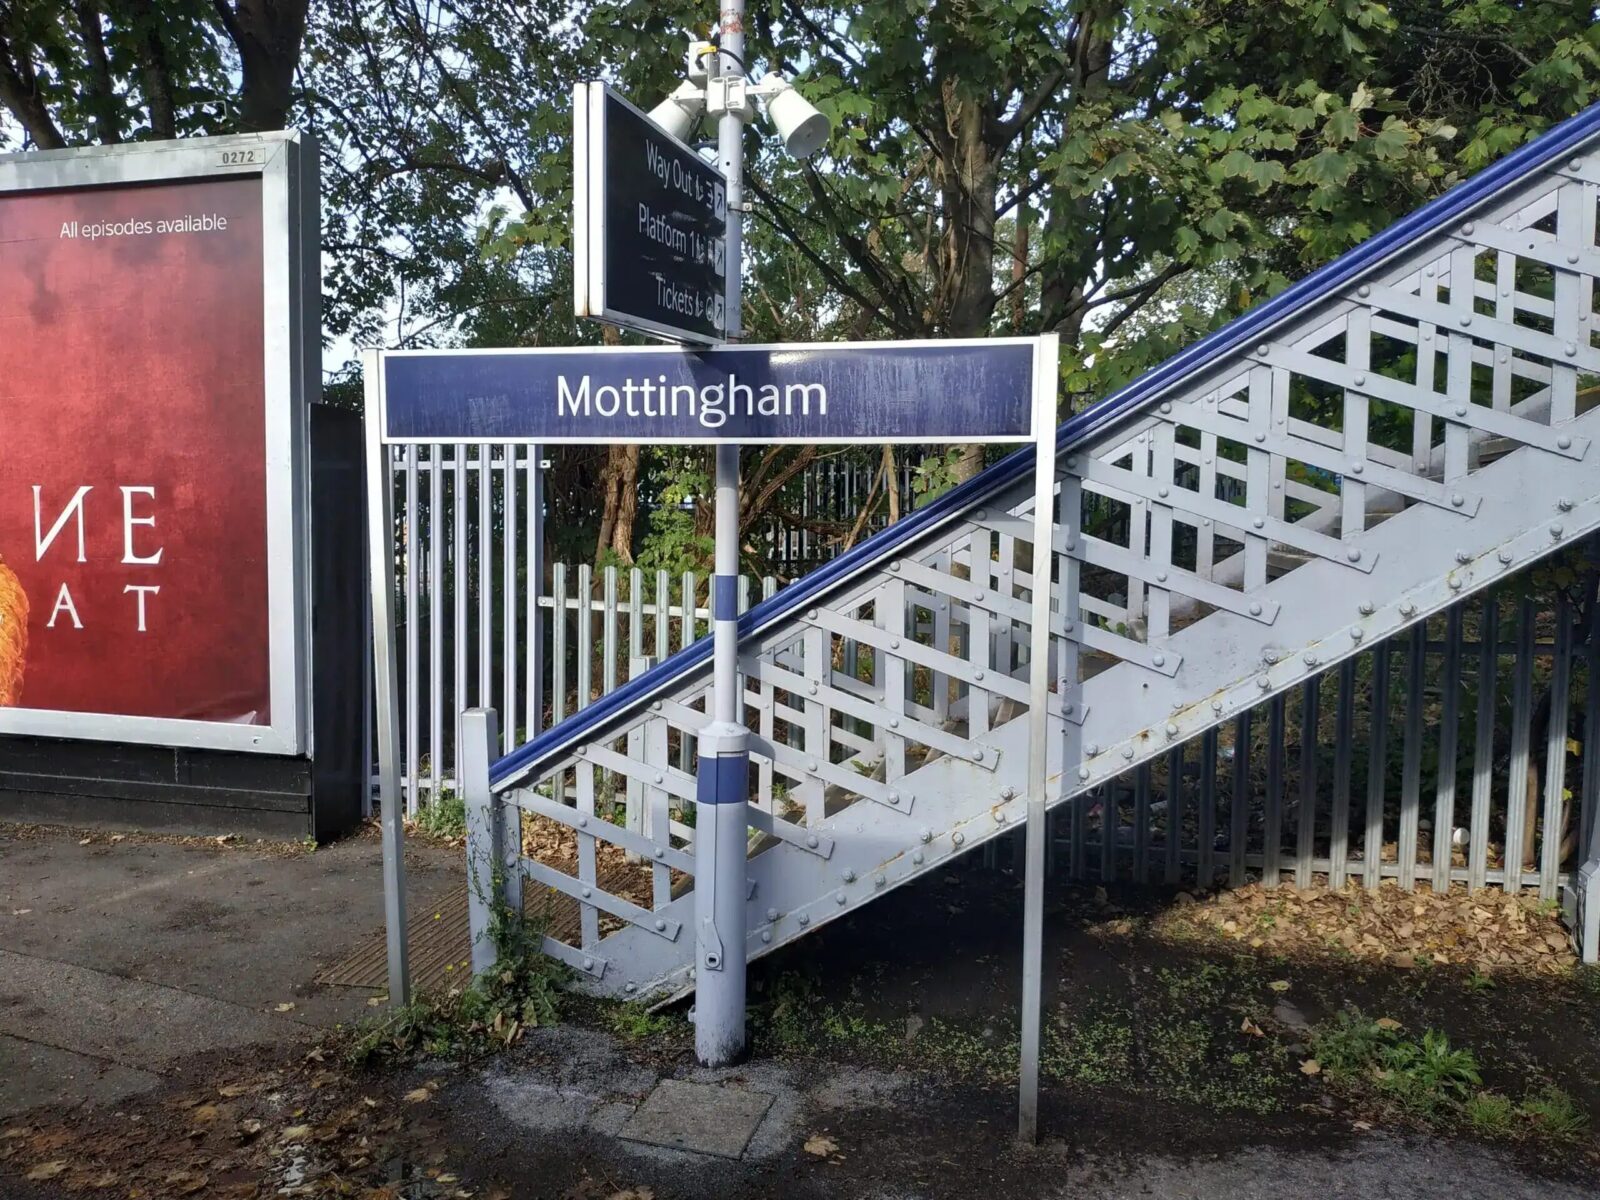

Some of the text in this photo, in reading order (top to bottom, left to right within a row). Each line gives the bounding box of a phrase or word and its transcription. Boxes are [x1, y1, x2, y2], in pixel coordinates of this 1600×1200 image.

[222, 151, 255, 164] 0272
[645, 139, 692, 198] Way Out
[60, 213, 228, 241] All episodes available
[638, 202, 696, 258] Platform 1
[655, 275, 694, 318] Tickets
[556, 374, 828, 429] Mottingham
